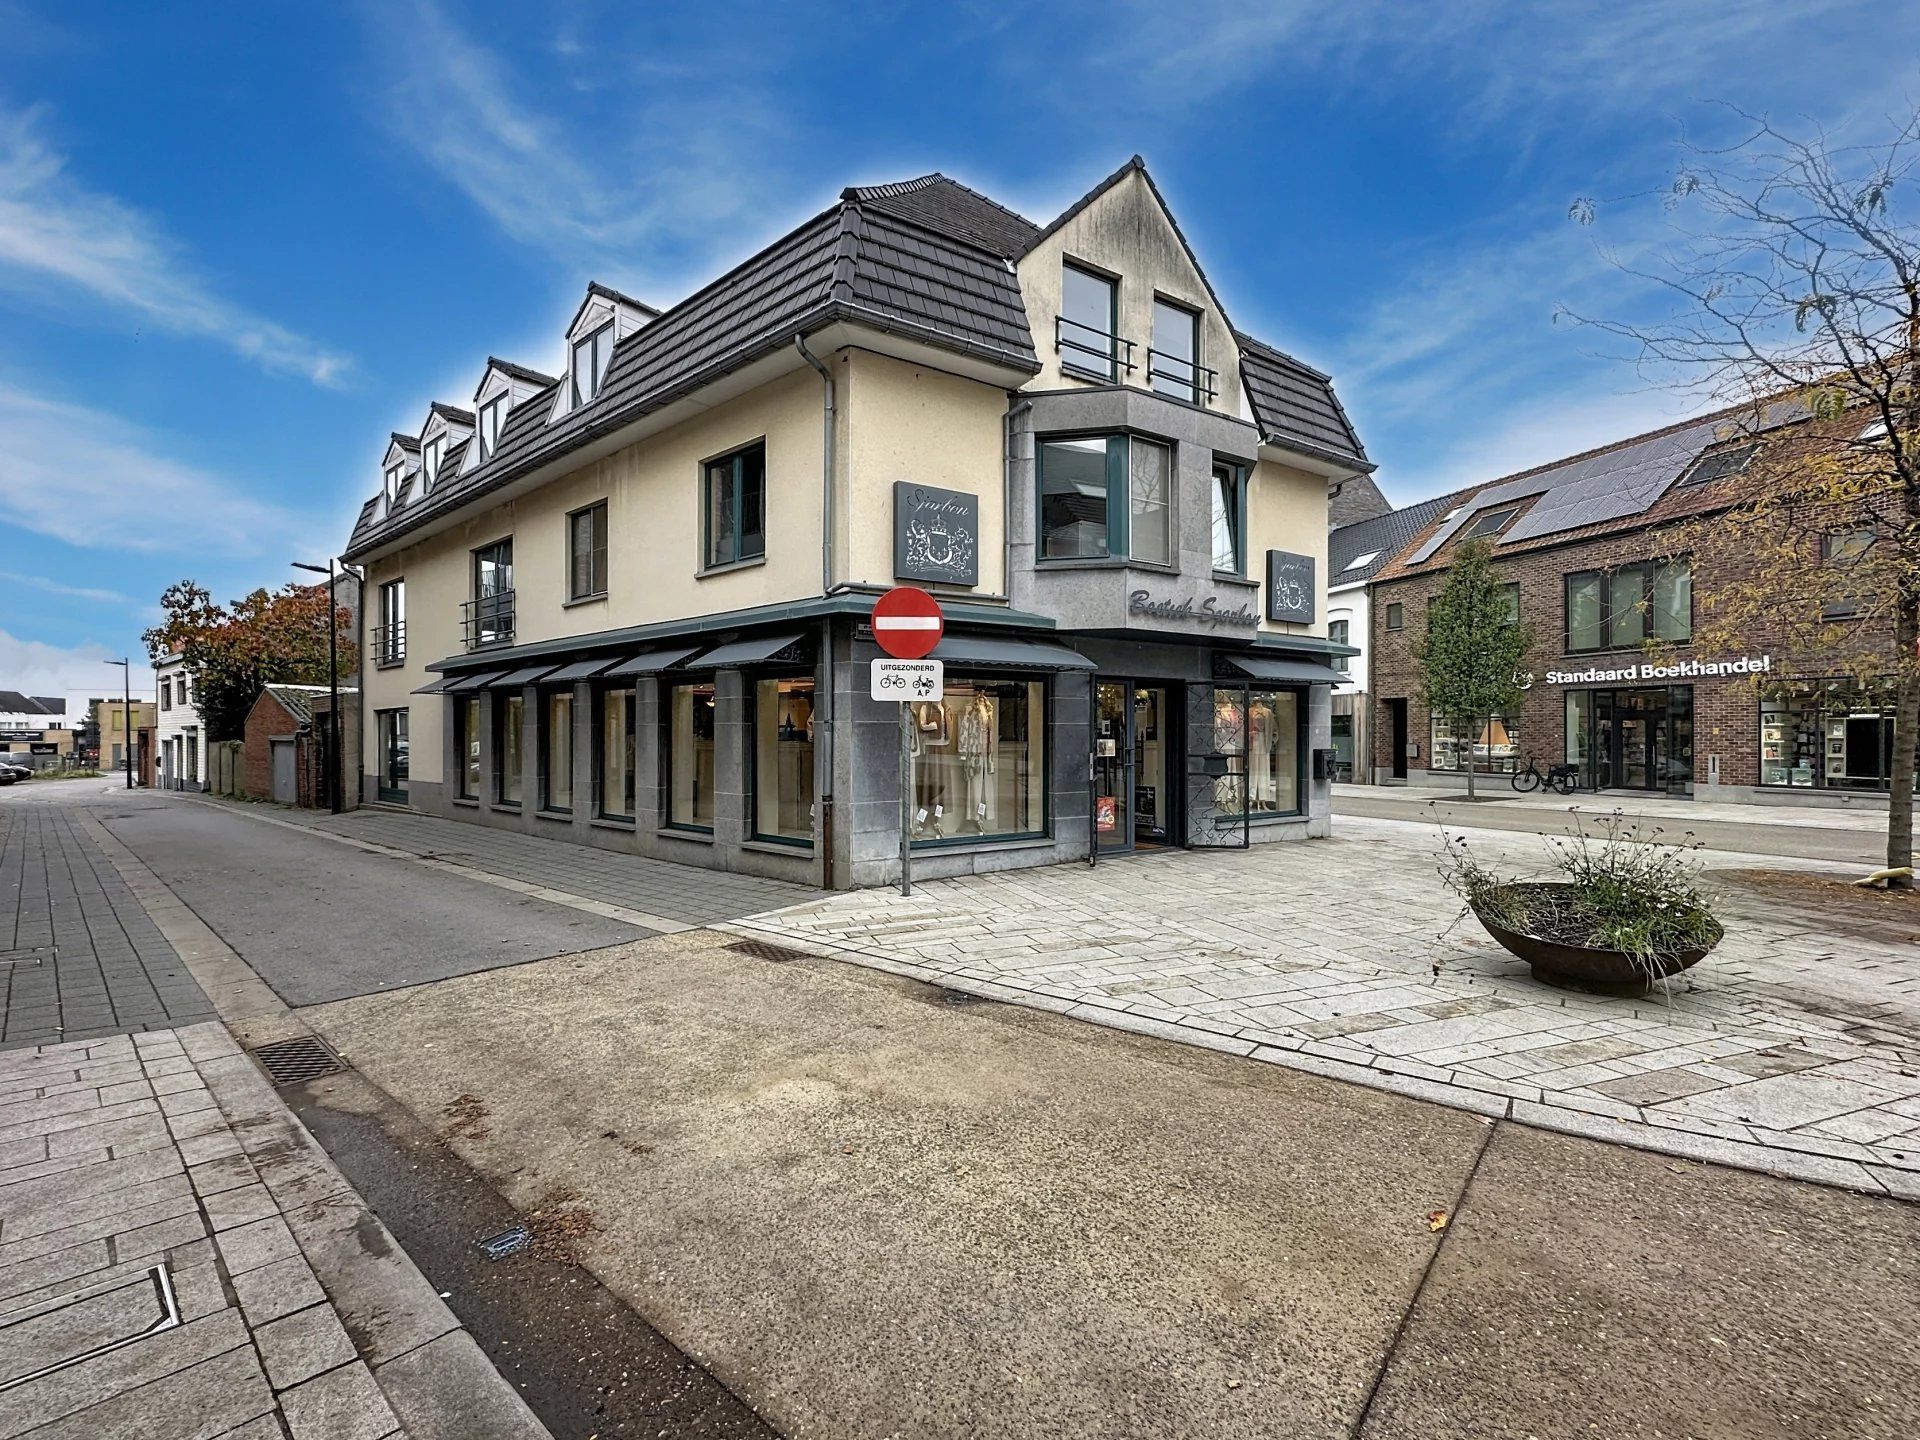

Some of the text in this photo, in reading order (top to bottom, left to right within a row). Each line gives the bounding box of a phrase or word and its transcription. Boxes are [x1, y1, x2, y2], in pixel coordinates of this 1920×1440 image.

[906, 488, 969, 516] Sjarbon
[880, 664, 935, 672] UITGEZONDERD
[1545, 655, 1770, 684] Standaard Boekhandel
[925, 689, 930, 697] P
